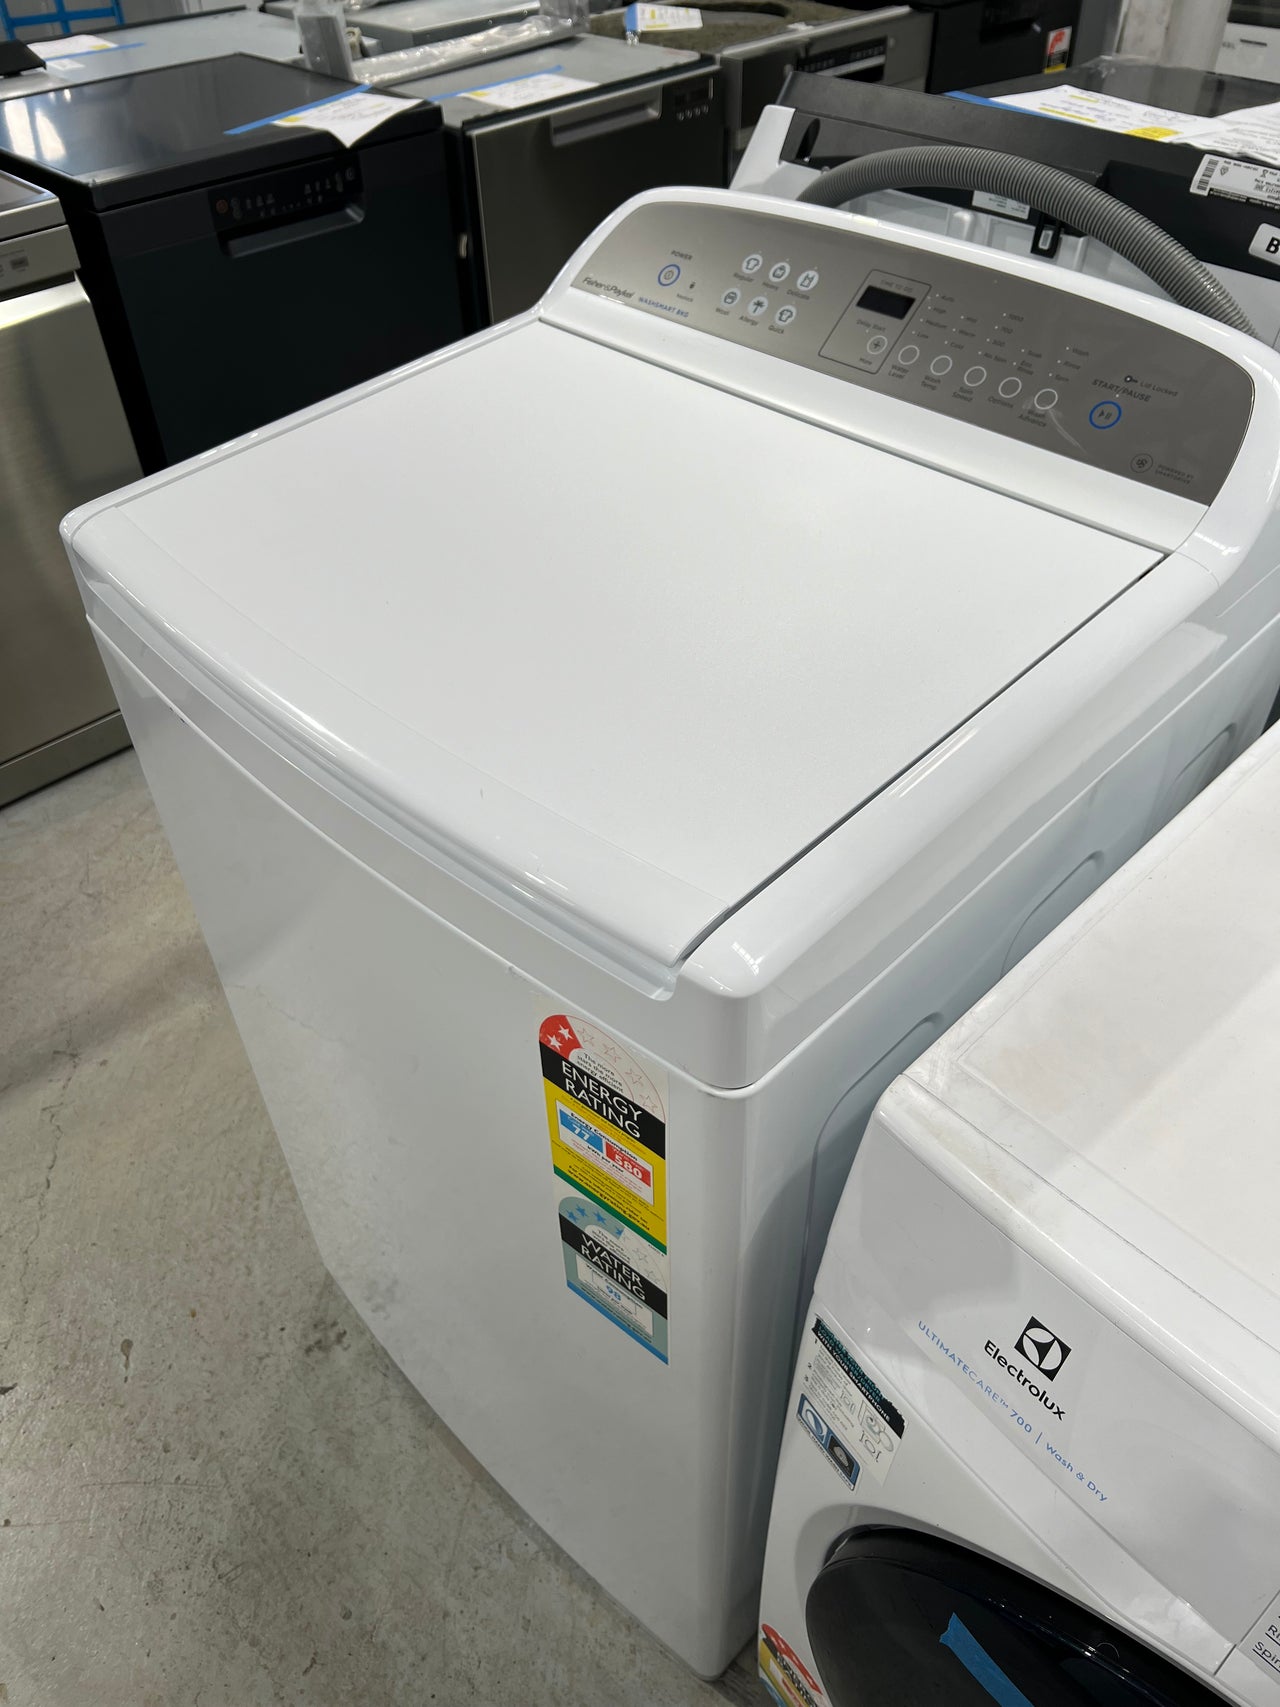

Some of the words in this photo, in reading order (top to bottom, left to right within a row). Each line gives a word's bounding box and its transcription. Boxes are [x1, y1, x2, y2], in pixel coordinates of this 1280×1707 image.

[671, 250, 692, 260] POWER
[768, 325, 784, 334] Quick
[1092, 378, 1152, 402] START/PAUSE
[1152, 384, 1178, 397] Locked
[584, 1052, 595, 1064] The
[597, 1061, 614, 1076] more
[561, 1059, 642, 1125] ENERGY
[565, 1077, 640, 1139] RATING
[570, 1111, 592, 1131] Energy
[593, 1127, 637, 1162] Consumption
[572, 1123, 590, 1144] 77
[614, 1152, 642, 1180] 580
[580, 1243, 645, 1302] RATING
[581, 1232, 643, 1289] WATER
[606, 1283, 621, 1302] 98
[816, 1329, 831, 1352] WITH
[831, 1348, 848, 1372] YOUR
[848, 1370, 890, 1423] SMARTPHONE
[984, 1339, 1066, 1421] Electrolux
[1010, 1408, 1032, 1434] 700
[1046, 1442, 1074, 1472] Wash
[1076, 1472, 1086, 1482] &
[1087, 1480, 1108, 1502] Dry
